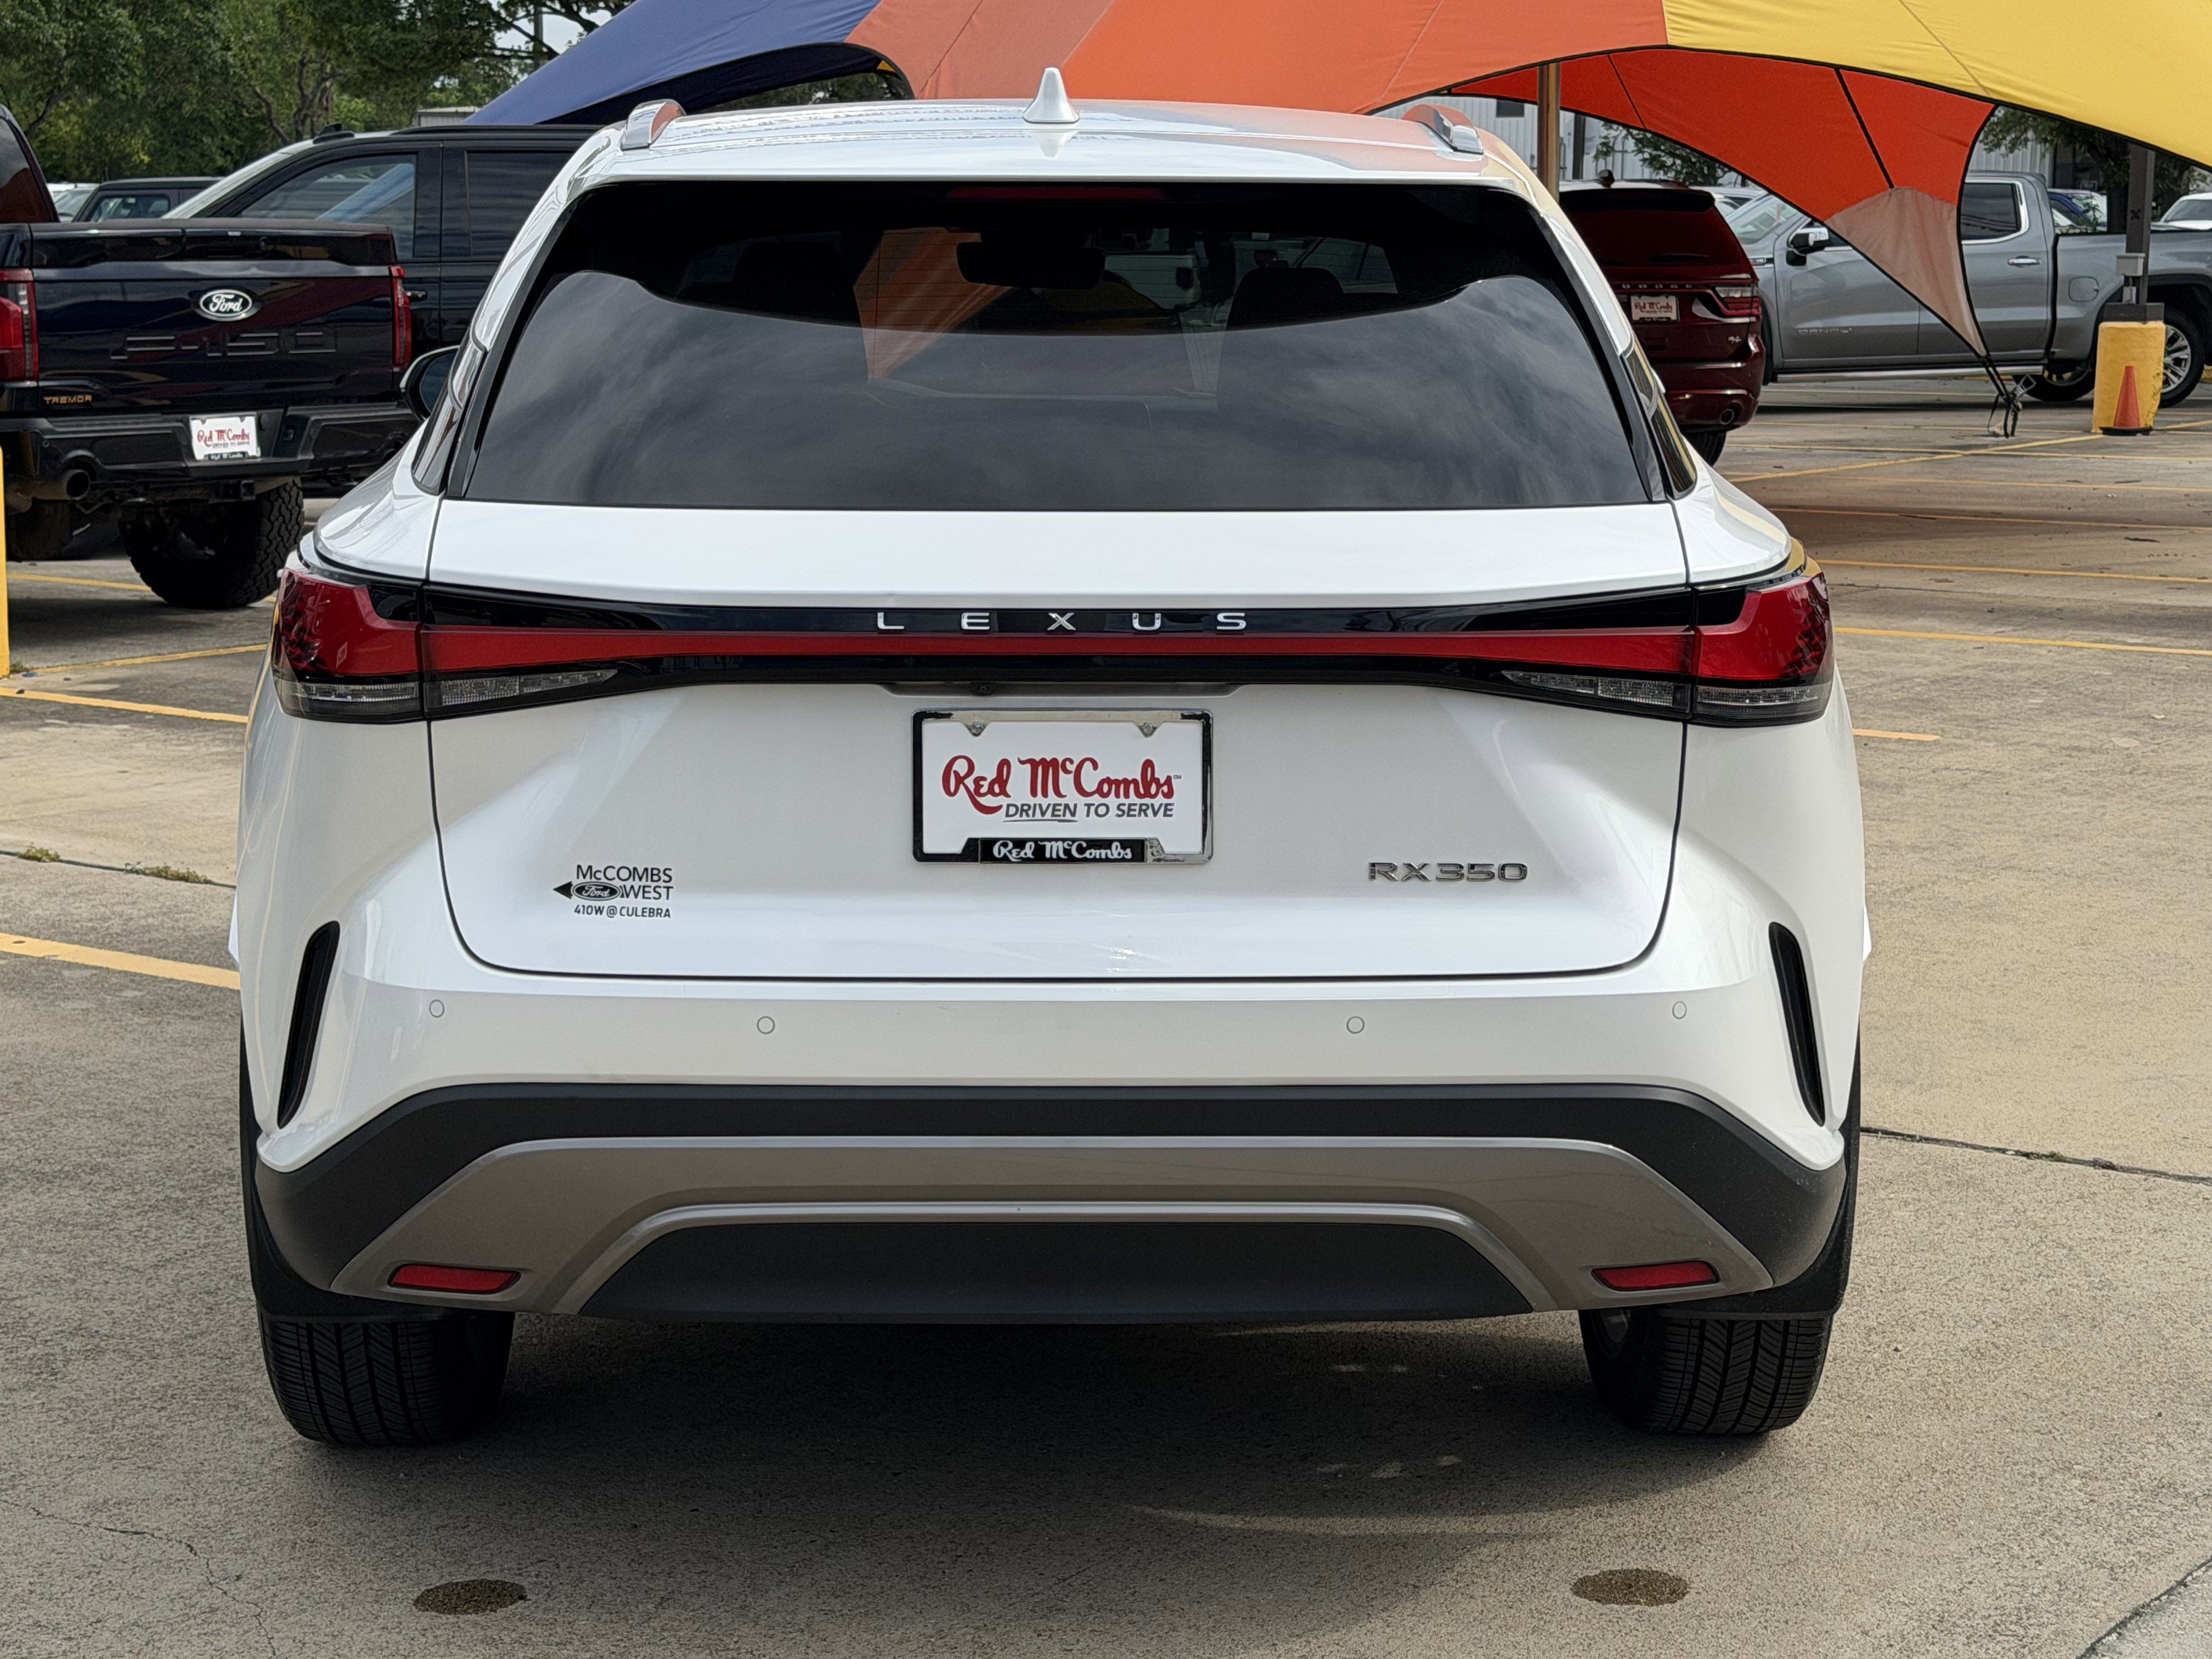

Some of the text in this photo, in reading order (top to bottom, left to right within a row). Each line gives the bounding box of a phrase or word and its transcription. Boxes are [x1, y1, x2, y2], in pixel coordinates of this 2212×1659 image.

[208, 294, 242, 312] Ford
[44, 395, 92, 404] TREMOR
[197, 430, 213, 448] Red
[877, 612, 1248, 631] LEXUS
[941, 754, 1175, 815] Red McCombs
[1004, 802, 1175, 818] DRIVEN TO SERVE
[992, 840, 1132, 861] Red McCombs
[576, 864, 673, 883] McCOMBS
[582, 884, 674, 900] Ford WEST
[619, 906, 671, 919] CULEBRA
